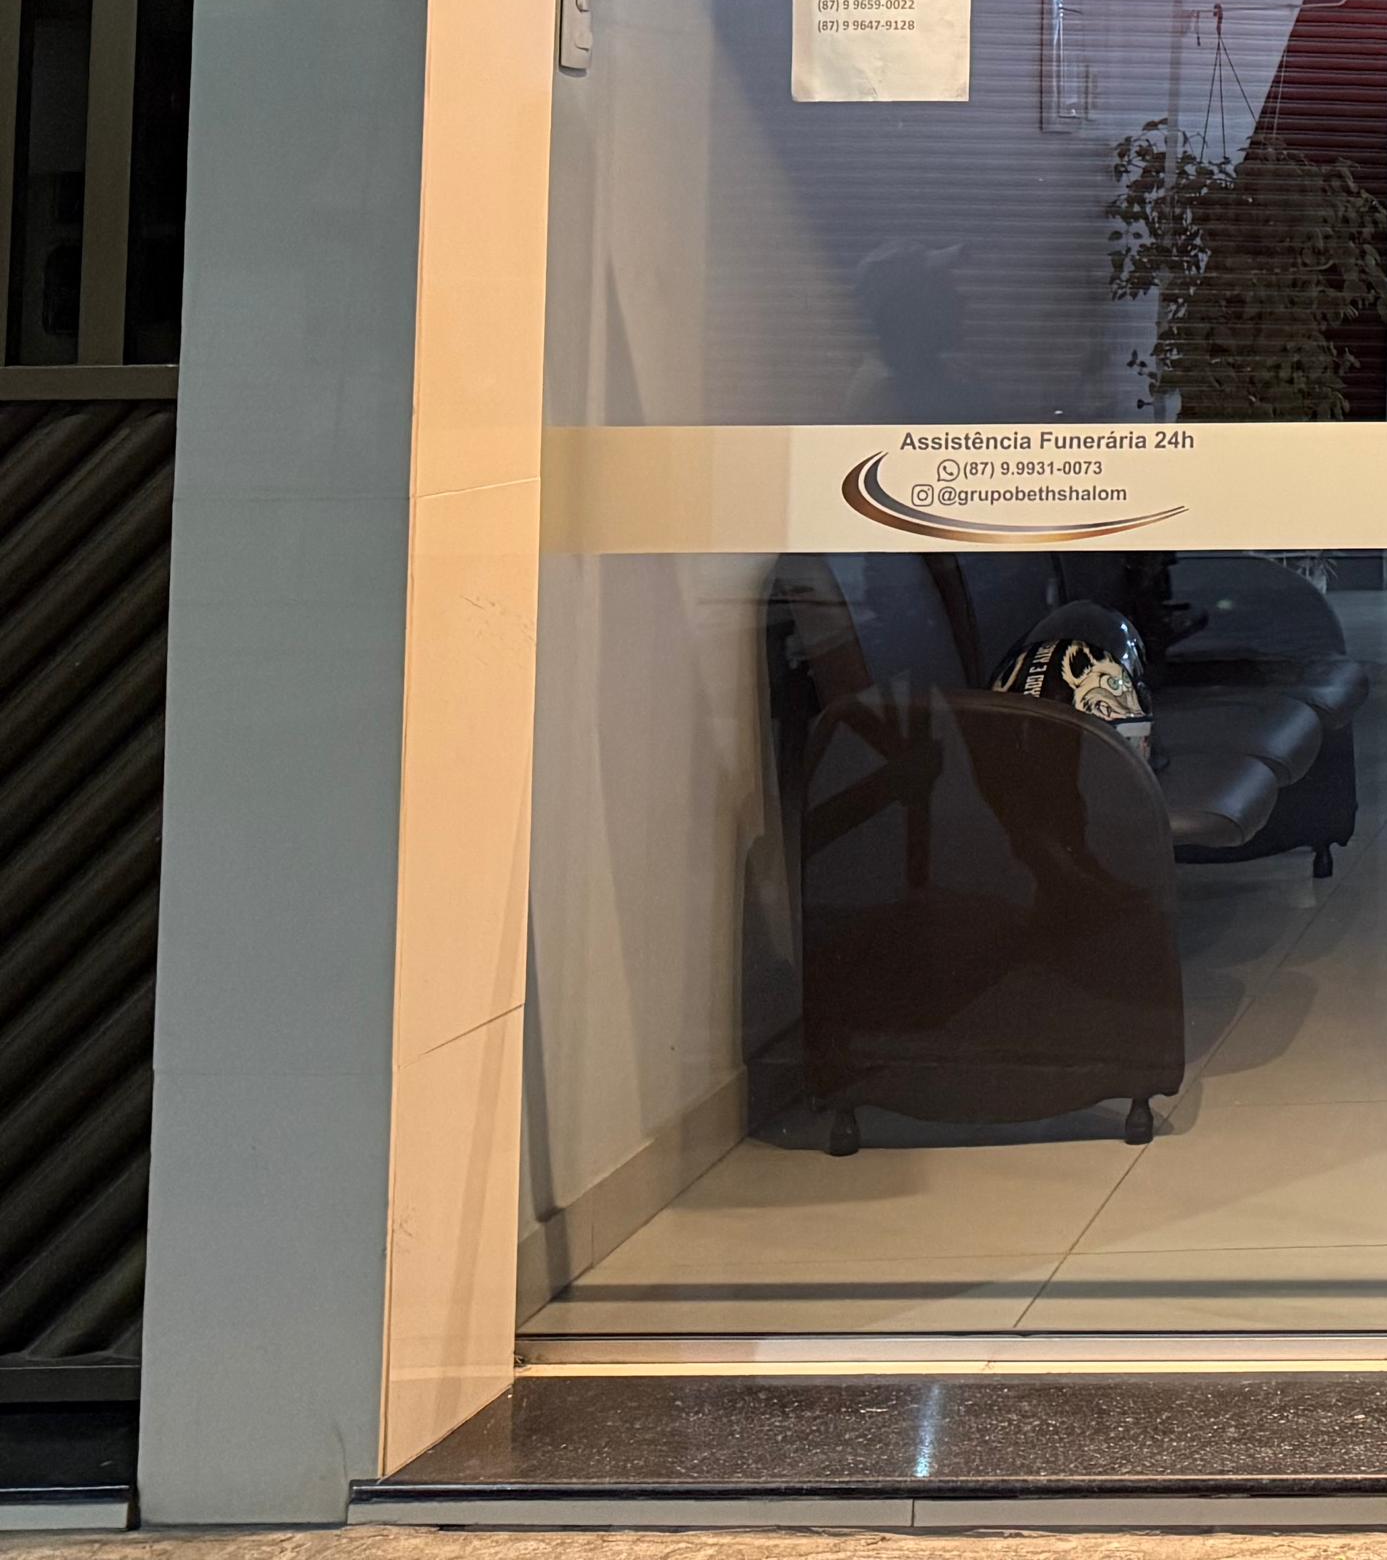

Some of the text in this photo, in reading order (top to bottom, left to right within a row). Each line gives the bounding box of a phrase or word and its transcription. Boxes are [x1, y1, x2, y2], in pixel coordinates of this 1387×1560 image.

[817, 0, 915, 12] (87) 9 9659-0022
[817, 20, 915, 33] (87) 9 9647-9128
[900, 430, 1194, 451] Assistência Funerária 24h
[963, 460, 1103, 479] (87) 9.9931-0073
[937, 485, 1127, 507] @grupobethshalom
